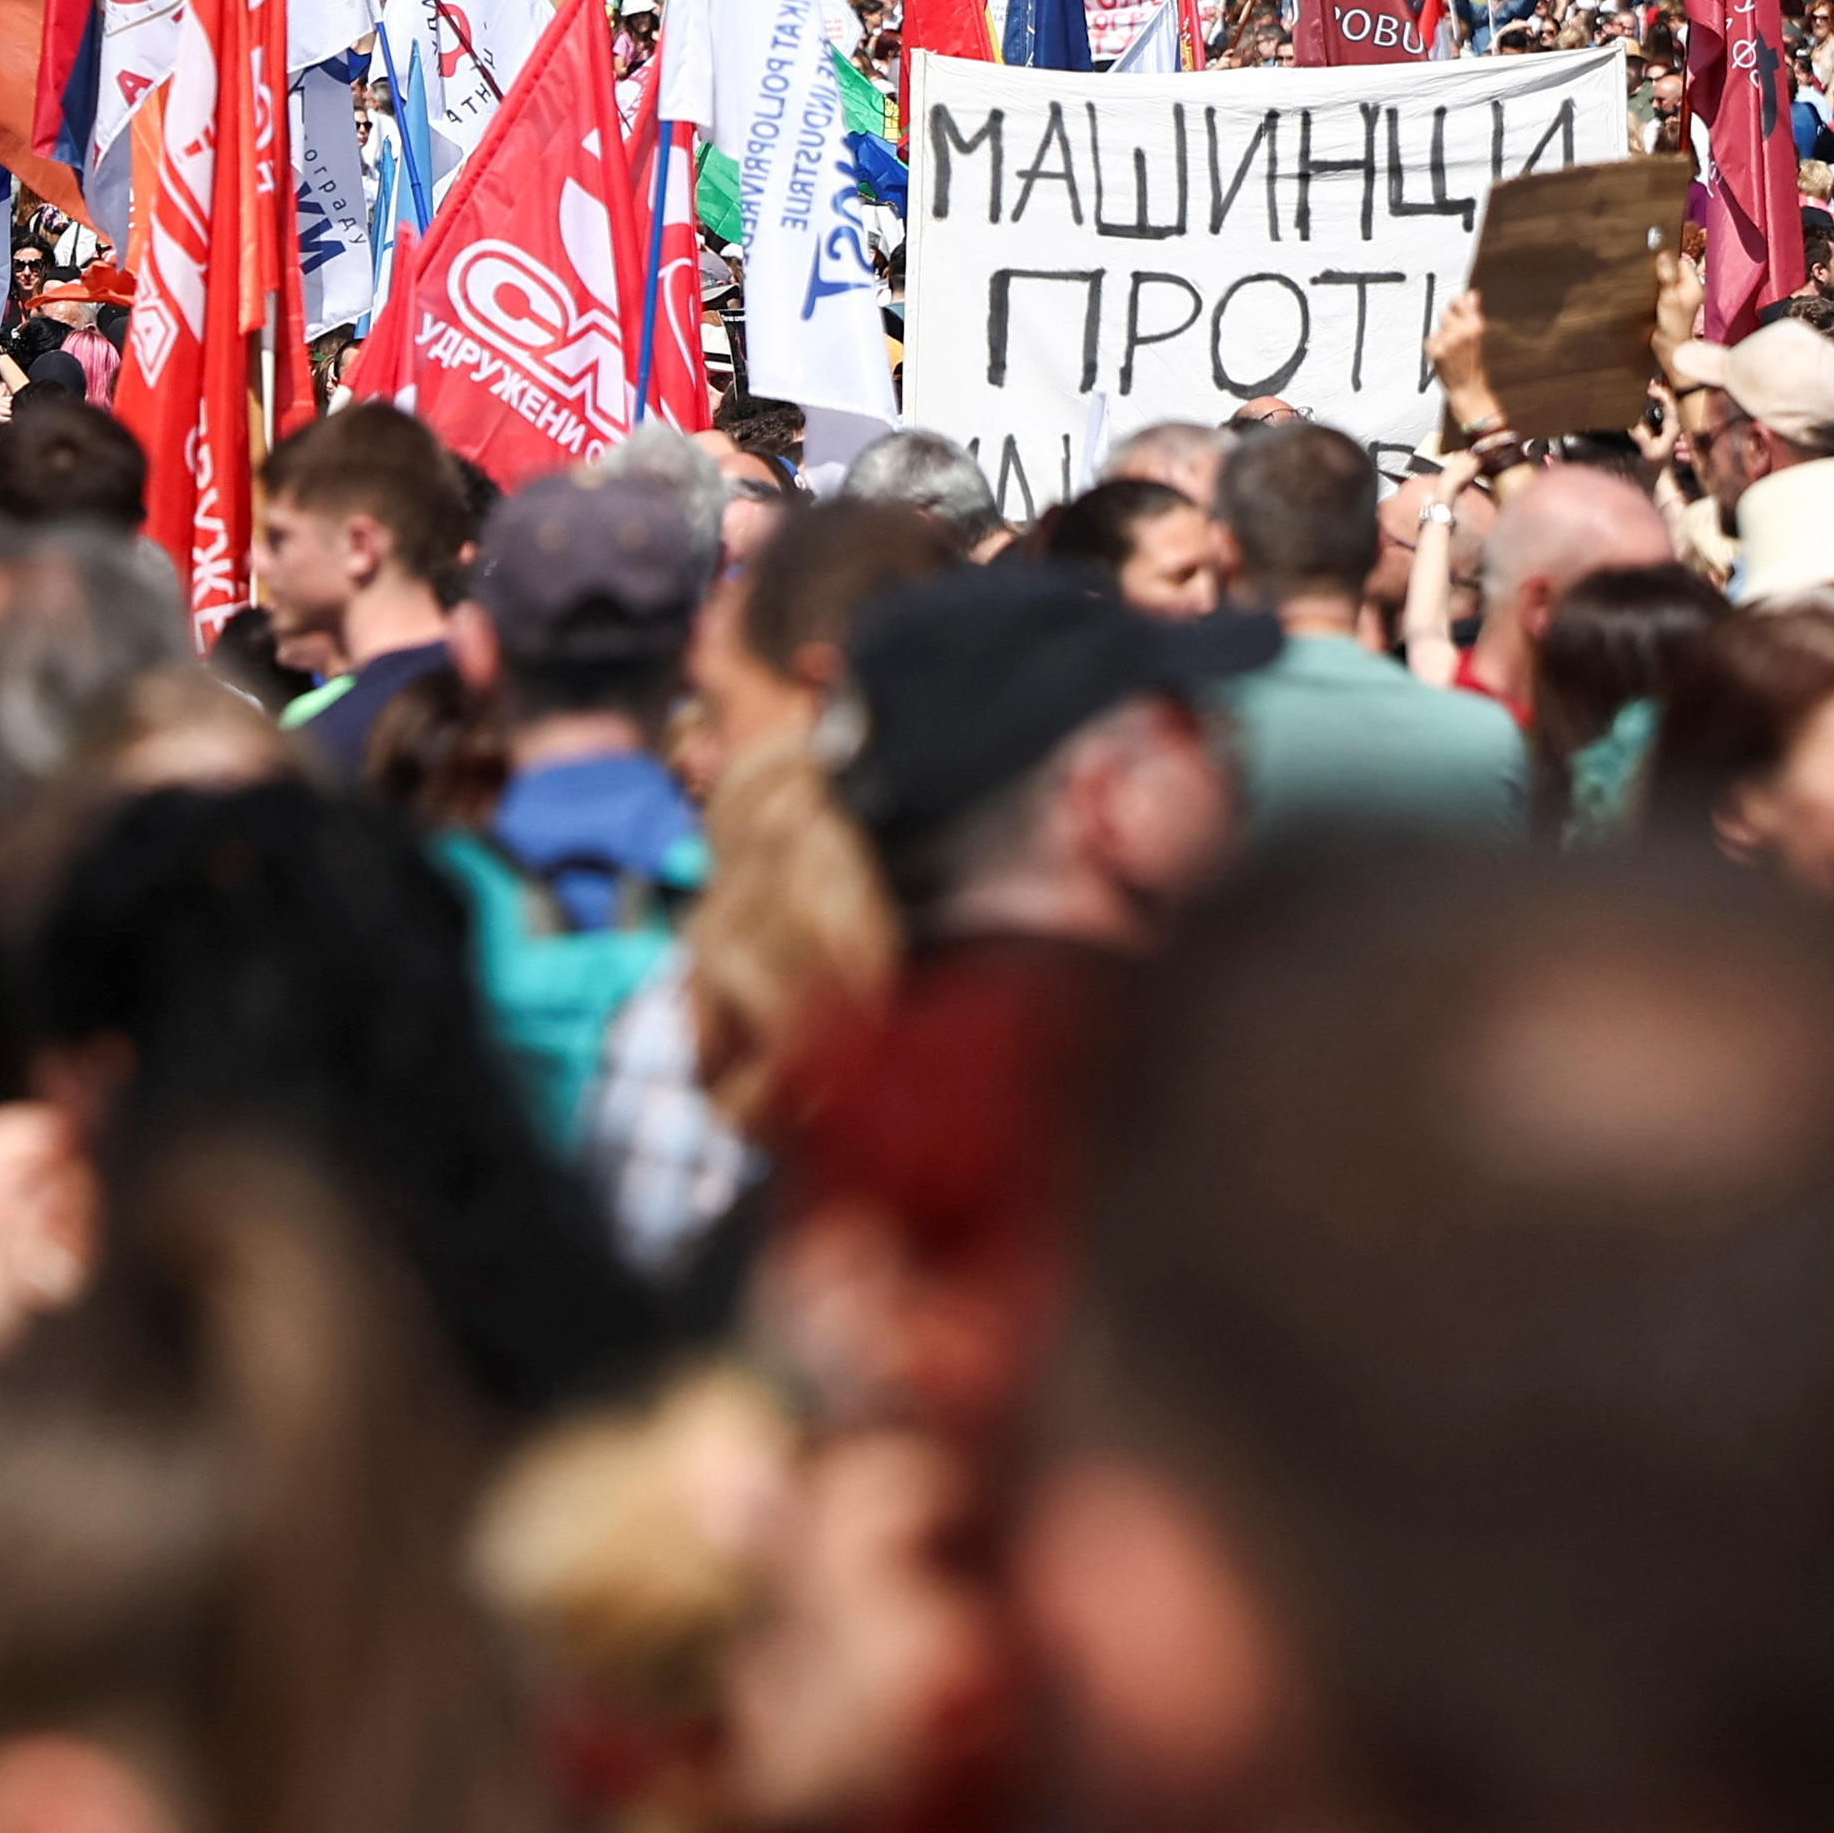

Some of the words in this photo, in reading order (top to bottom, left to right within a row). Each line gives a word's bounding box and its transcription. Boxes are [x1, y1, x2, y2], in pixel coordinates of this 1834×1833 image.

[303, 133, 367, 245] ограду
[930, 98, 1575, 242] МАШИНЦИ
[414, 312, 587, 455] УДРУЖЕНИ
